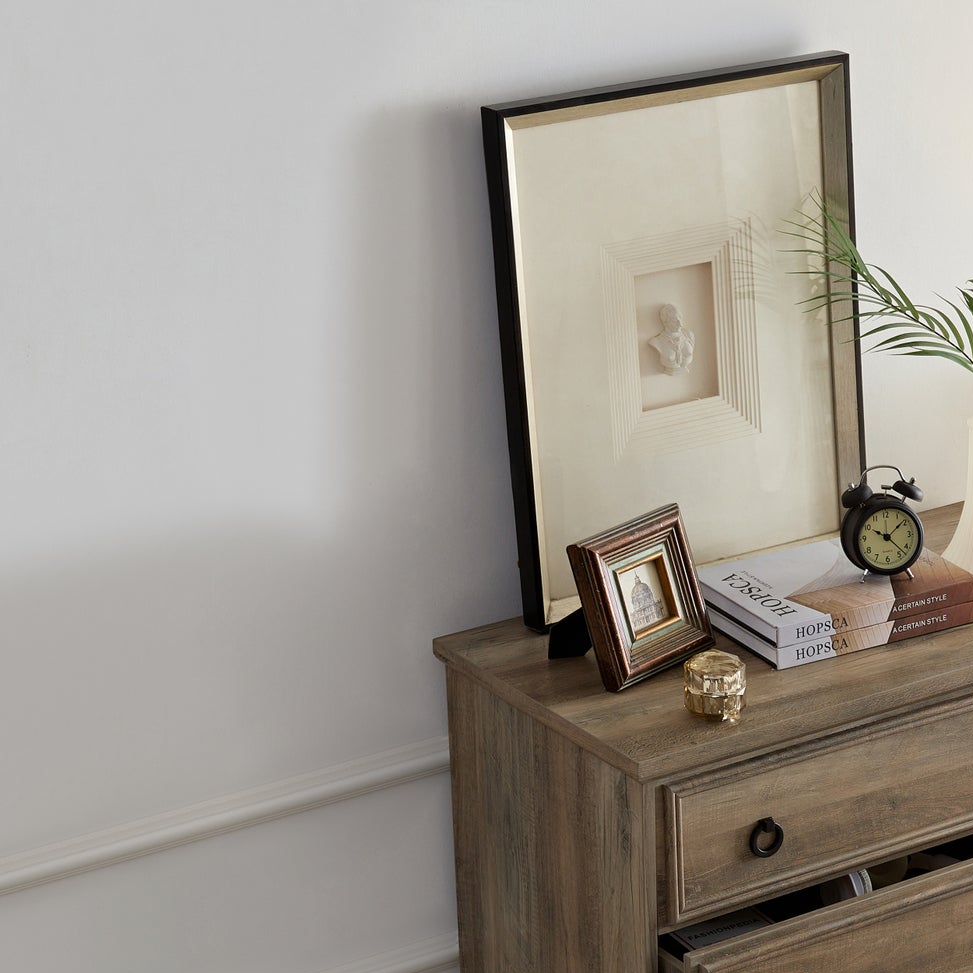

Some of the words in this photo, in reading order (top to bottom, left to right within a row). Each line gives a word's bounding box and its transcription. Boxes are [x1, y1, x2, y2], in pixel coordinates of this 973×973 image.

[721, 573, 798, 617] HOPSCA
[897, 599, 926, 612] CERTAIN
[926, 593, 948, 605] STYLE
[795, 617, 849, 639] HOPSCA
[897, 620, 926, 633] CERTAIN
[926, 614, 948, 626] STYLE
[795, 638, 849, 660] HOPSCA
[687, 918, 760, 941] FASHIONPEDIA
